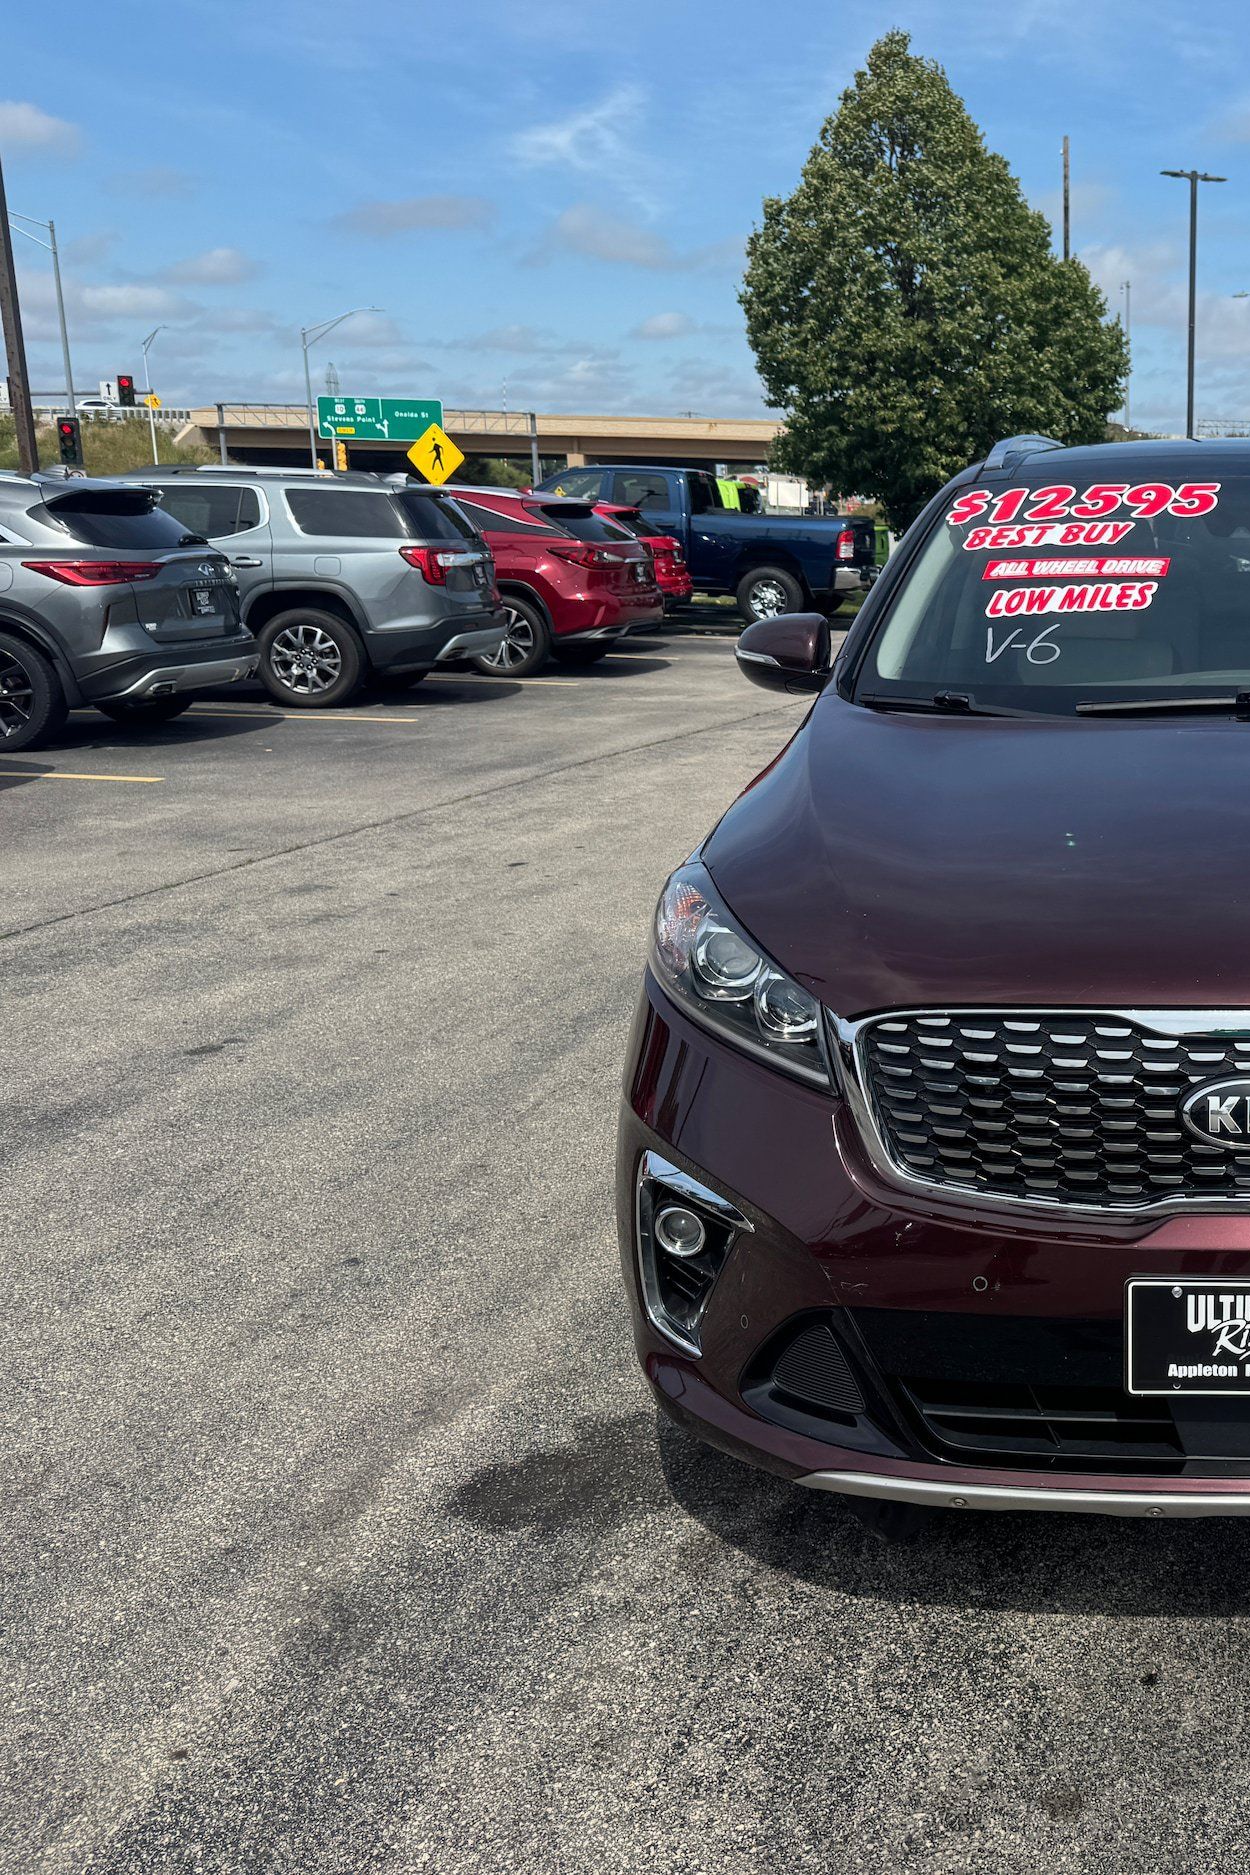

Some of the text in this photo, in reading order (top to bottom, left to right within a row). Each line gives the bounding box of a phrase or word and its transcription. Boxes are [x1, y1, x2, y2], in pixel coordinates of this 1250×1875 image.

[947, 483, 1221, 525] $12595
[963, 522, 1135, 549] BEST BUY
[989, 558, 1165, 576] ALL WHEEL DRIVE
[986, 582, 1157, 617] LOW MILES
[985, 624, 1061, 665] V-6
[1168, 1363, 1238, 1378] Appleton
